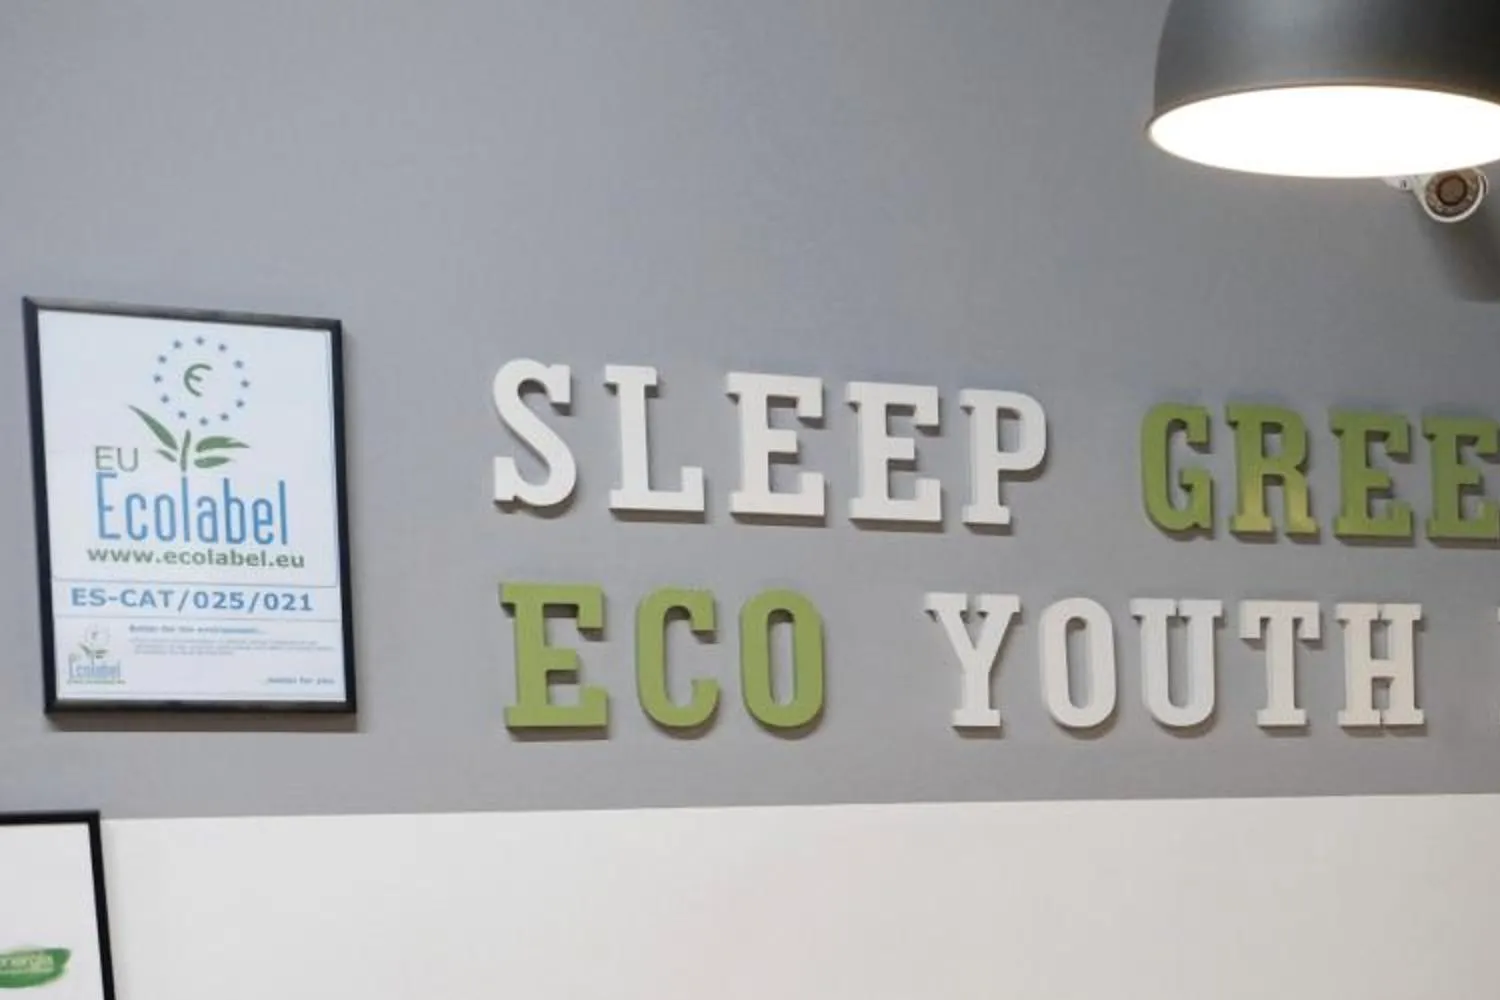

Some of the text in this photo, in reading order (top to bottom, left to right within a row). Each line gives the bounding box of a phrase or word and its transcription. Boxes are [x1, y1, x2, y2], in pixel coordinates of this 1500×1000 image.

[95, 446, 139, 472] EU
[493, 358, 1047, 526] SLEEP
[96, 471, 288, 545] Ecolabel
[87, 549, 306, 569] www.ecolabel.eu
[71, 587, 314, 614] ES-CAT/025/021
[500, 582, 825, 728] ECO
[924, 592, 1425, 728] YOUTH
